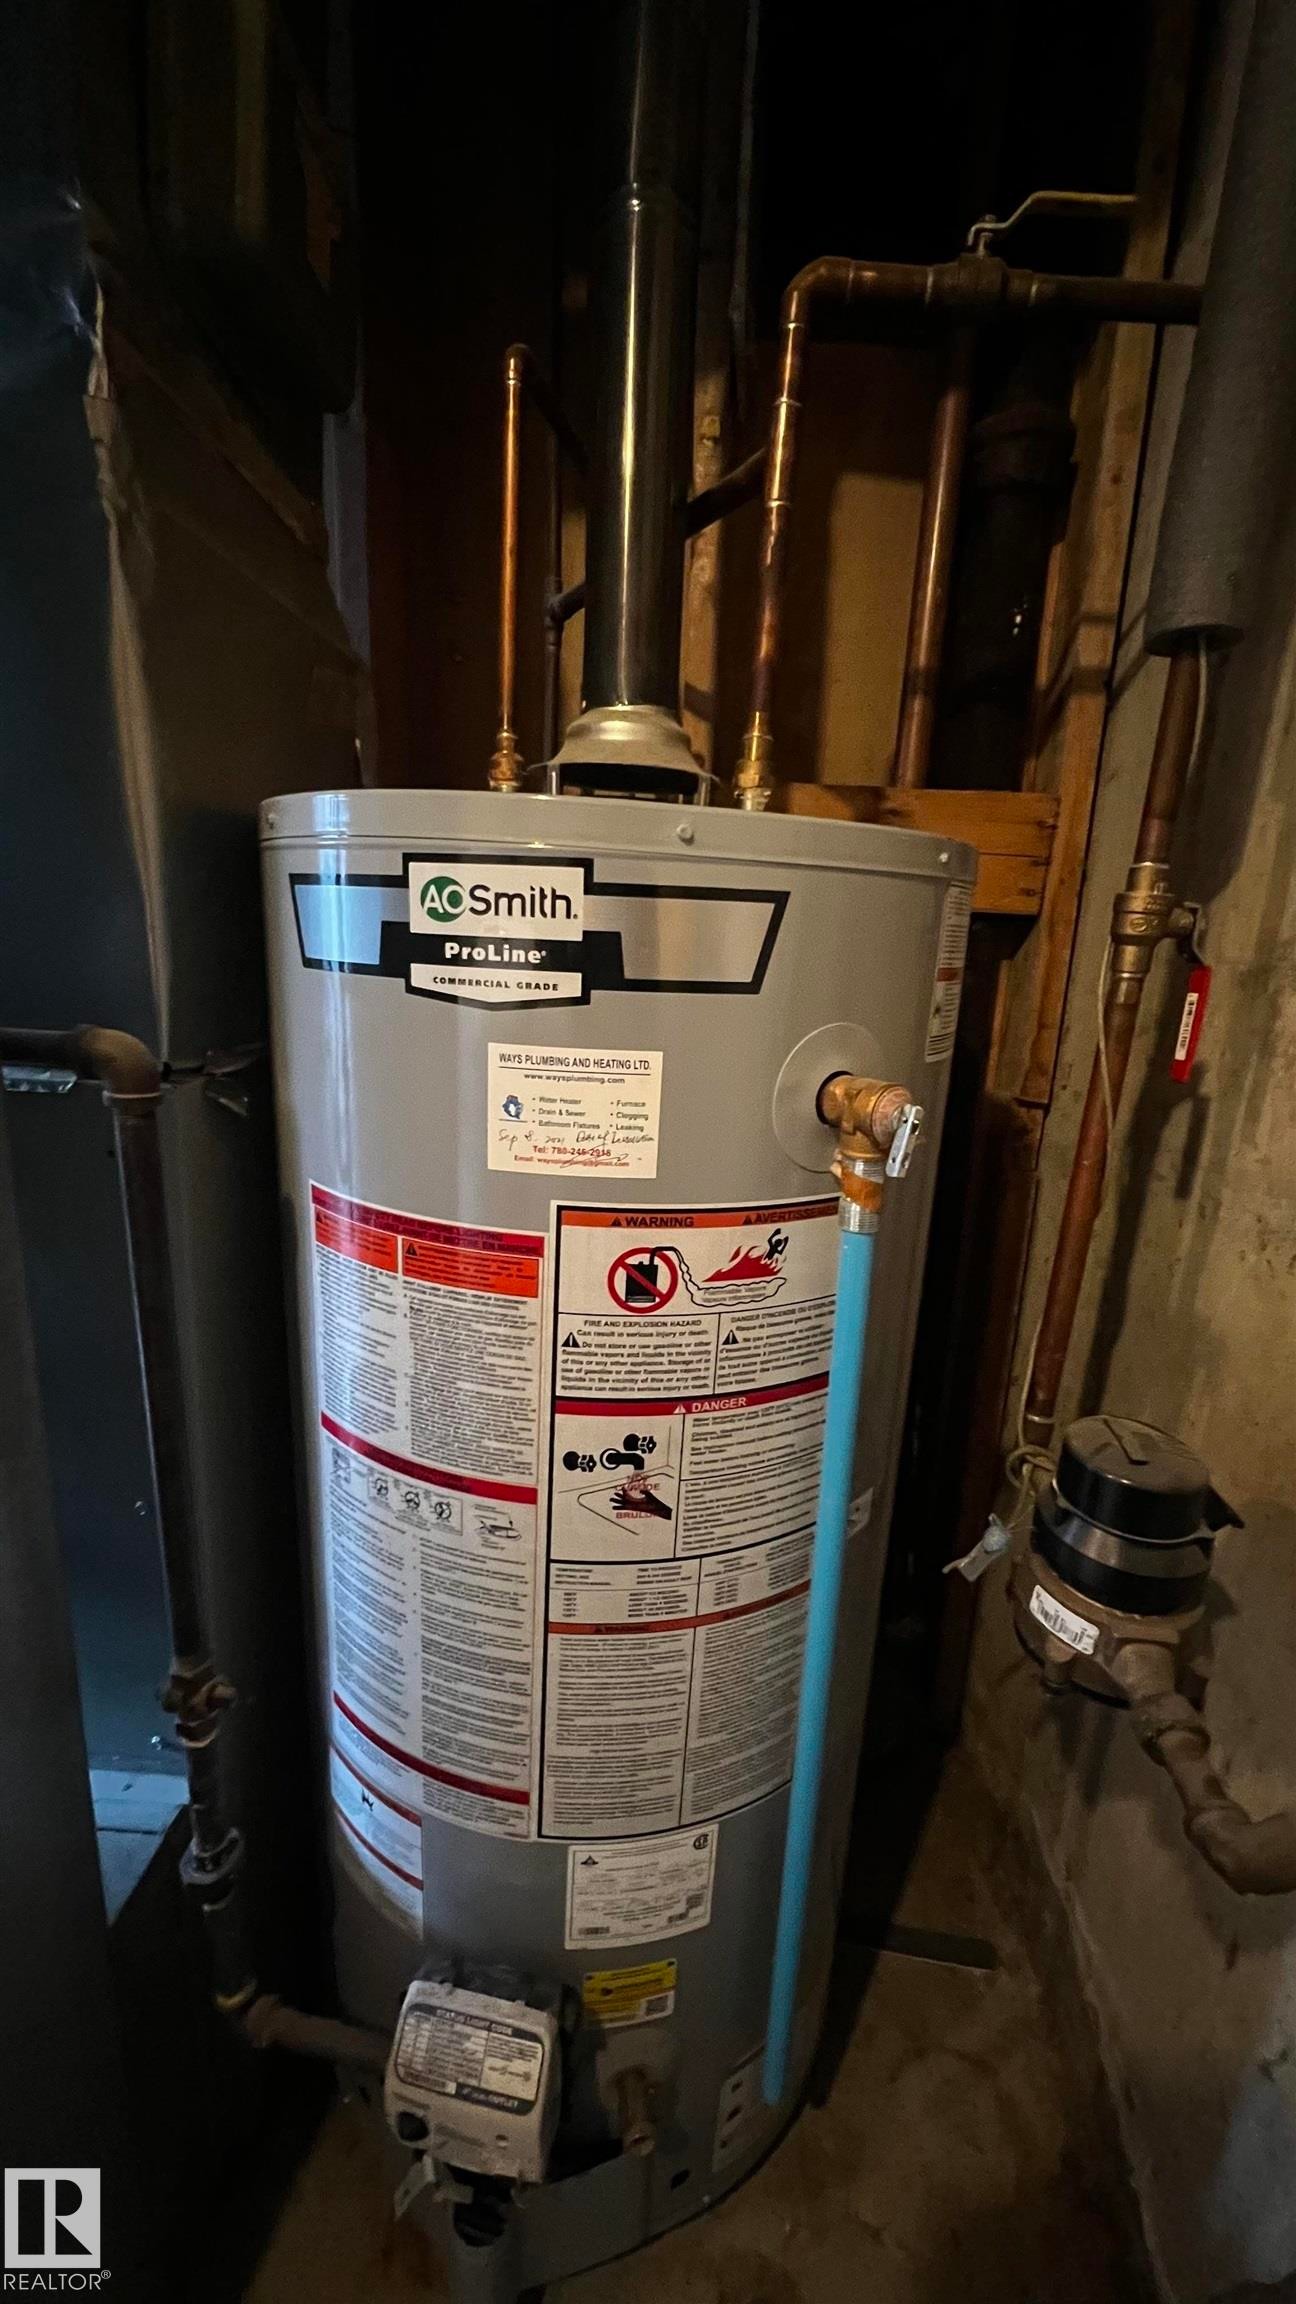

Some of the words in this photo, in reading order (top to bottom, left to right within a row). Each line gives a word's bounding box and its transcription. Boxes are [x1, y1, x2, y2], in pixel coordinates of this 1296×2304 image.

[433, 976, 510, 988] COMMERCIAL
[517, 982, 558, 991] GRADE
[499, 1053, 522, 1064] WAYS
[525, 1055, 570, 1067] PLUMBING
[572, 1058, 591, 1068] AND
[593, 1059, 631, 1070] HEATING
[633, 1060, 651, 1070] LTD.
[524, 1074, 625, 1085] www.waysplumbing.com
[616, 1112, 648, 1121] Clogging
[616, 1123, 644, 1132] Leaking
[625, 1216, 695, 1228] WARNING
[692, 1397, 746, 1412] DANGER
